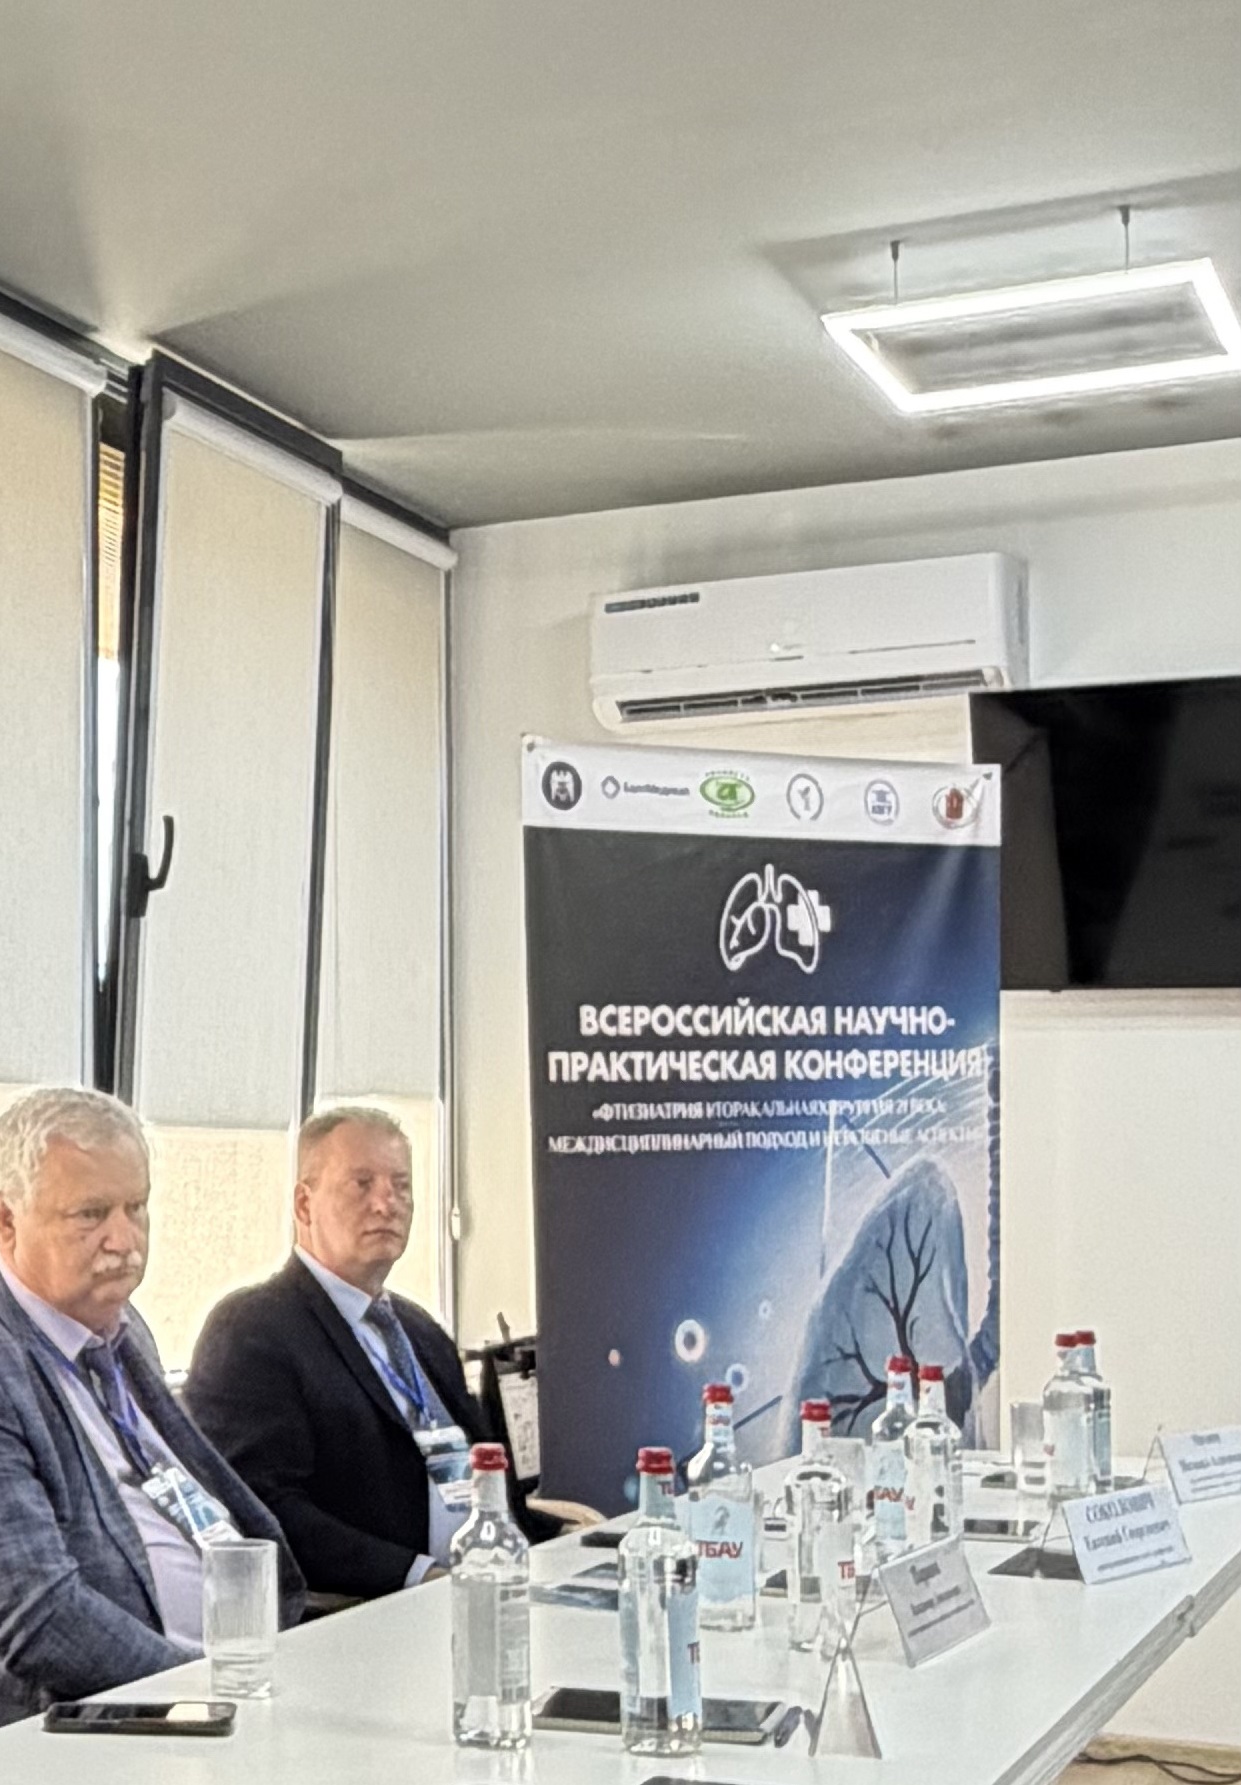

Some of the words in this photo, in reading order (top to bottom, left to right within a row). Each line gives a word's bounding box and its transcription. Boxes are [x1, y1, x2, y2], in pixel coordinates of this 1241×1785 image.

[578, 997, 827, 1037] ВСЕРОССИЙСКАЯ
[834, 1005, 956, 1036] НАУЧНО-
[547, 1050, 777, 1083] ПРАКТИЧЕСКАЯ
[784, 1048, 984, 1081] КОНФЕРЕНЦИЯ
[696, 1539, 744, 1559] ТБАУ
